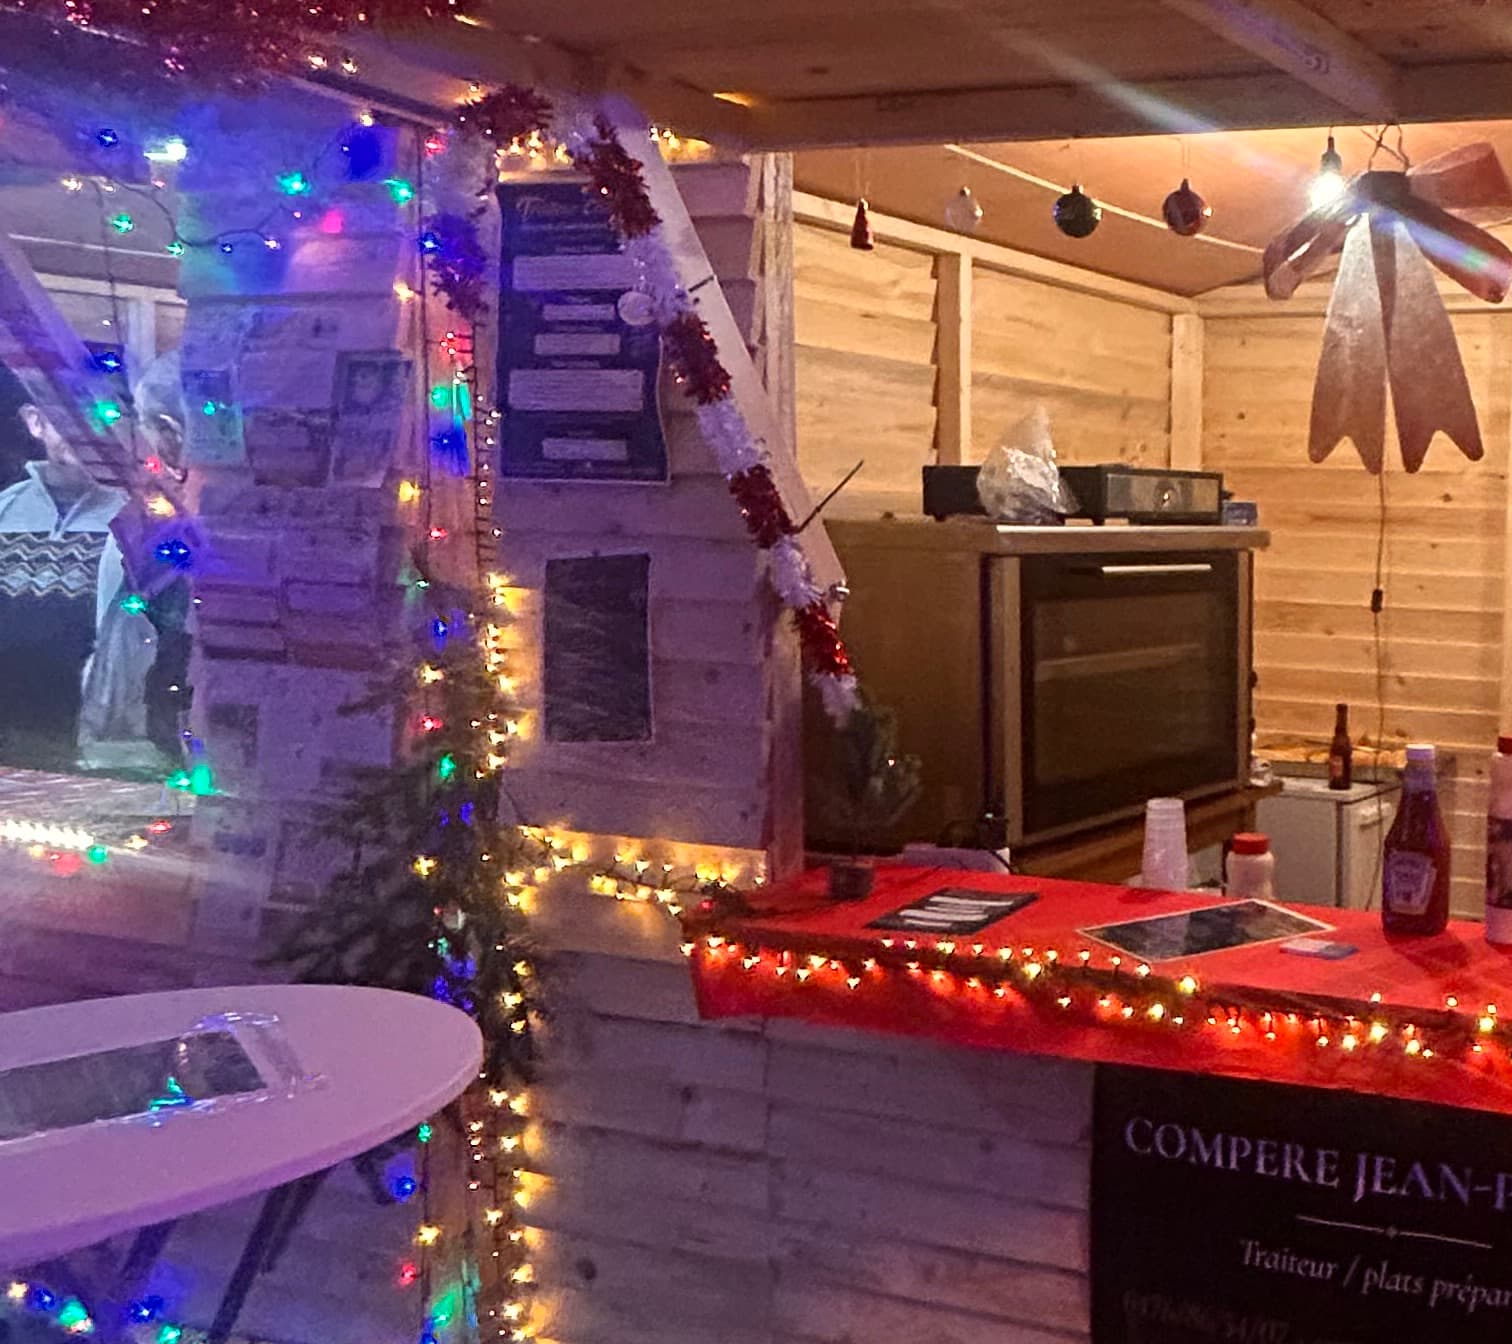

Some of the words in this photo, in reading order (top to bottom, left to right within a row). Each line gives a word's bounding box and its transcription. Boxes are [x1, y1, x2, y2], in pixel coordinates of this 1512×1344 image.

[1124, 1116, 1340, 1189] COMPERE
[1239, 1239, 1338, 1281] Traiteur
[1360, 1259, 1424, 1295] plats
